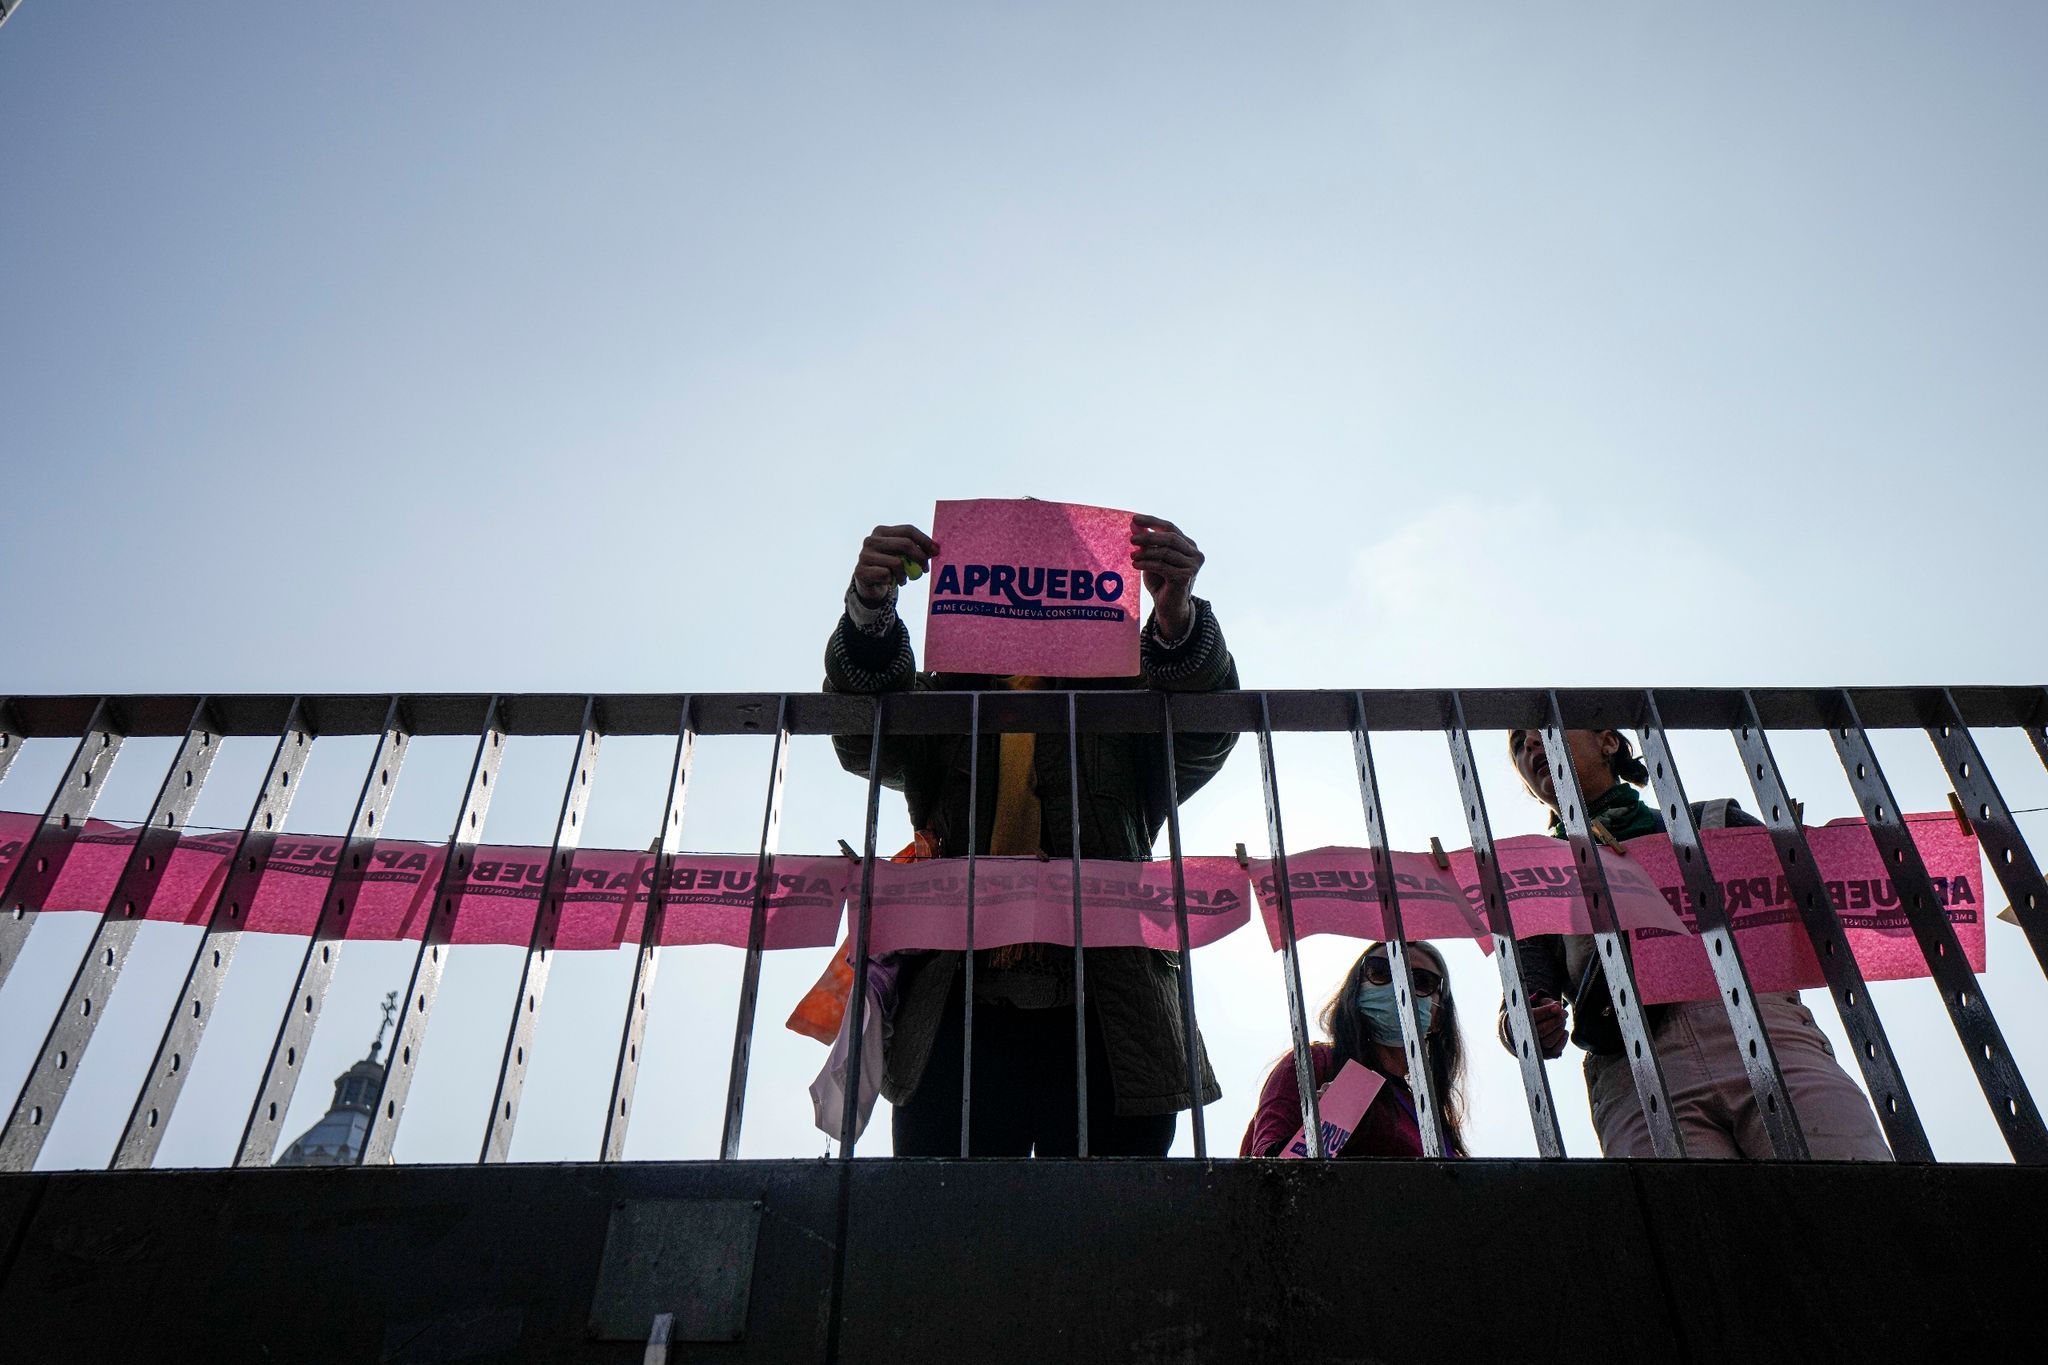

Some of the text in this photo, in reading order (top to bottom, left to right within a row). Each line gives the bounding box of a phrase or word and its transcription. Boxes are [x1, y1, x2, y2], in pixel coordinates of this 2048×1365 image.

[934, 564, 1124, 603] APRUEBO
[936, 603, 957, 612] #ME
[994, 606, 1006, 615] LA
[1009, 608, 1044, 618] NUEVA
[1045, 609, 1119, 619] CONSTITUCION
